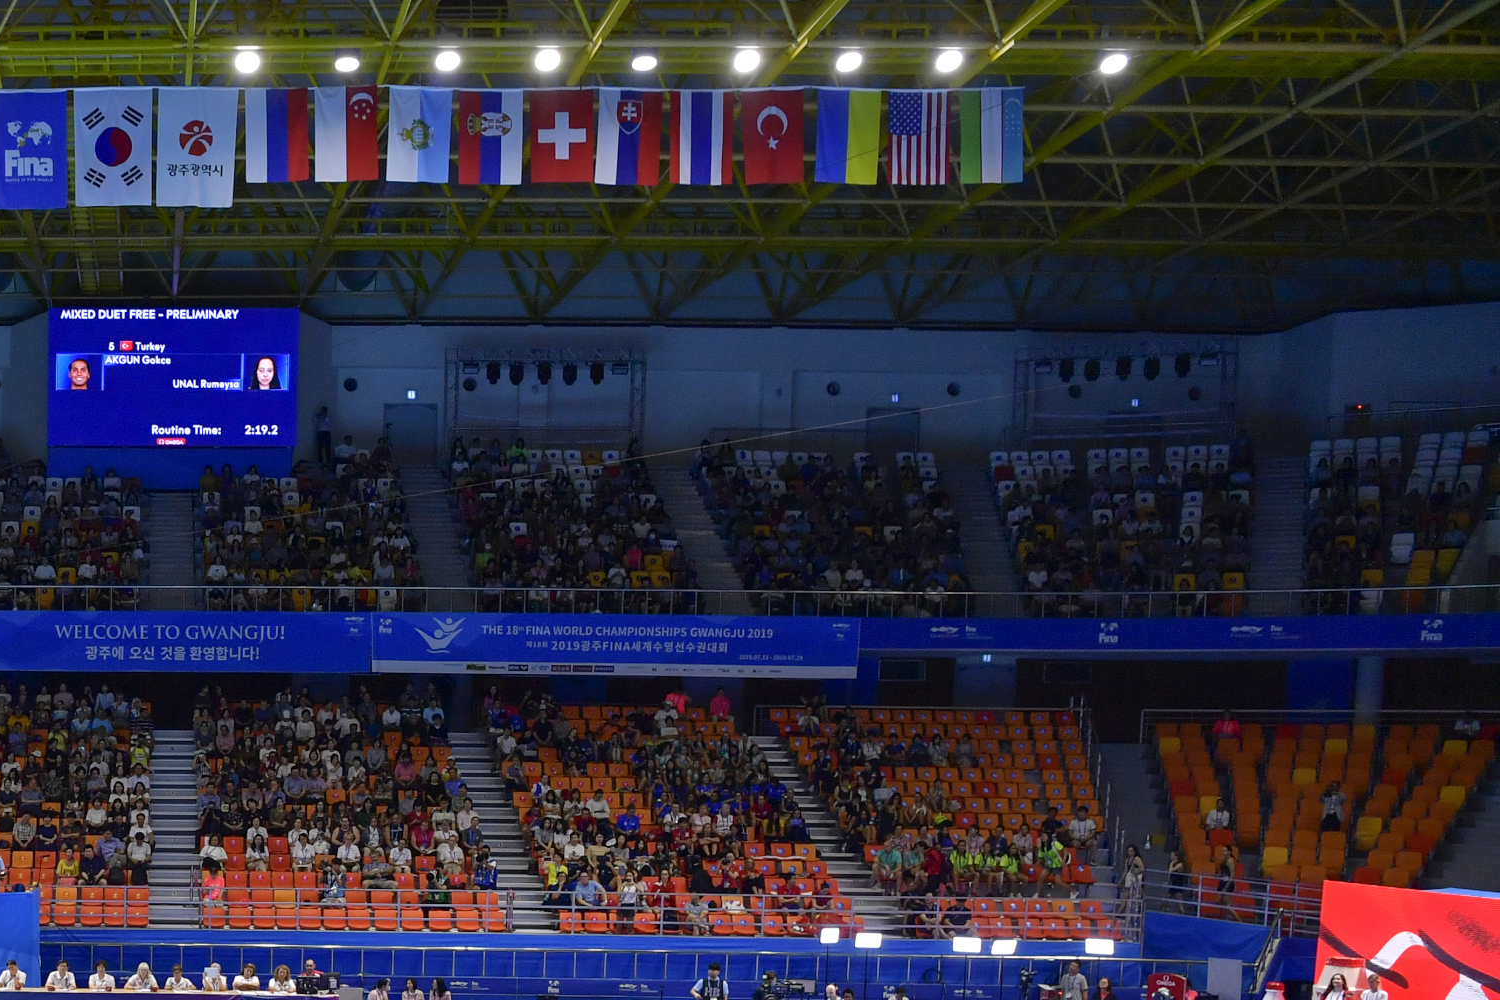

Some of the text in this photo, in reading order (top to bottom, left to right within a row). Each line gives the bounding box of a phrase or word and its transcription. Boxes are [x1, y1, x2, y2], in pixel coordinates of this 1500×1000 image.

[166, 163, 224, 178] 광주광역시
[60, 309, 96, 320] MIXED
[98, 309, 128, 320] DUET
[129, 309, 157, 320] FREE
[166, 309, 240, 320] PRELIMINARY
[108, 342, 166, 353] 5 Turkey
[105, 355, 172, 365] AKGUN Gokce
[172, 379, 240, 391] UNAL Rumeysa
[151, 424, 279, 436] Routine Time: 2:19.2
[54, 623, 285, 643] WELCOME TO GWANGJU!
[481, 624, 504, 635] THE
[525, 625, 550, 637] FINA
[552, 625, 593, 637] WORLD
[594, 626, 688, 638] CHAMPIONSHIPS
[689, 627, 745, 639] GWANGJU
[747, 628, 773, 639] 2019
[85, 646, 260, 662] 광주에 오신 것을 환영합니다!
